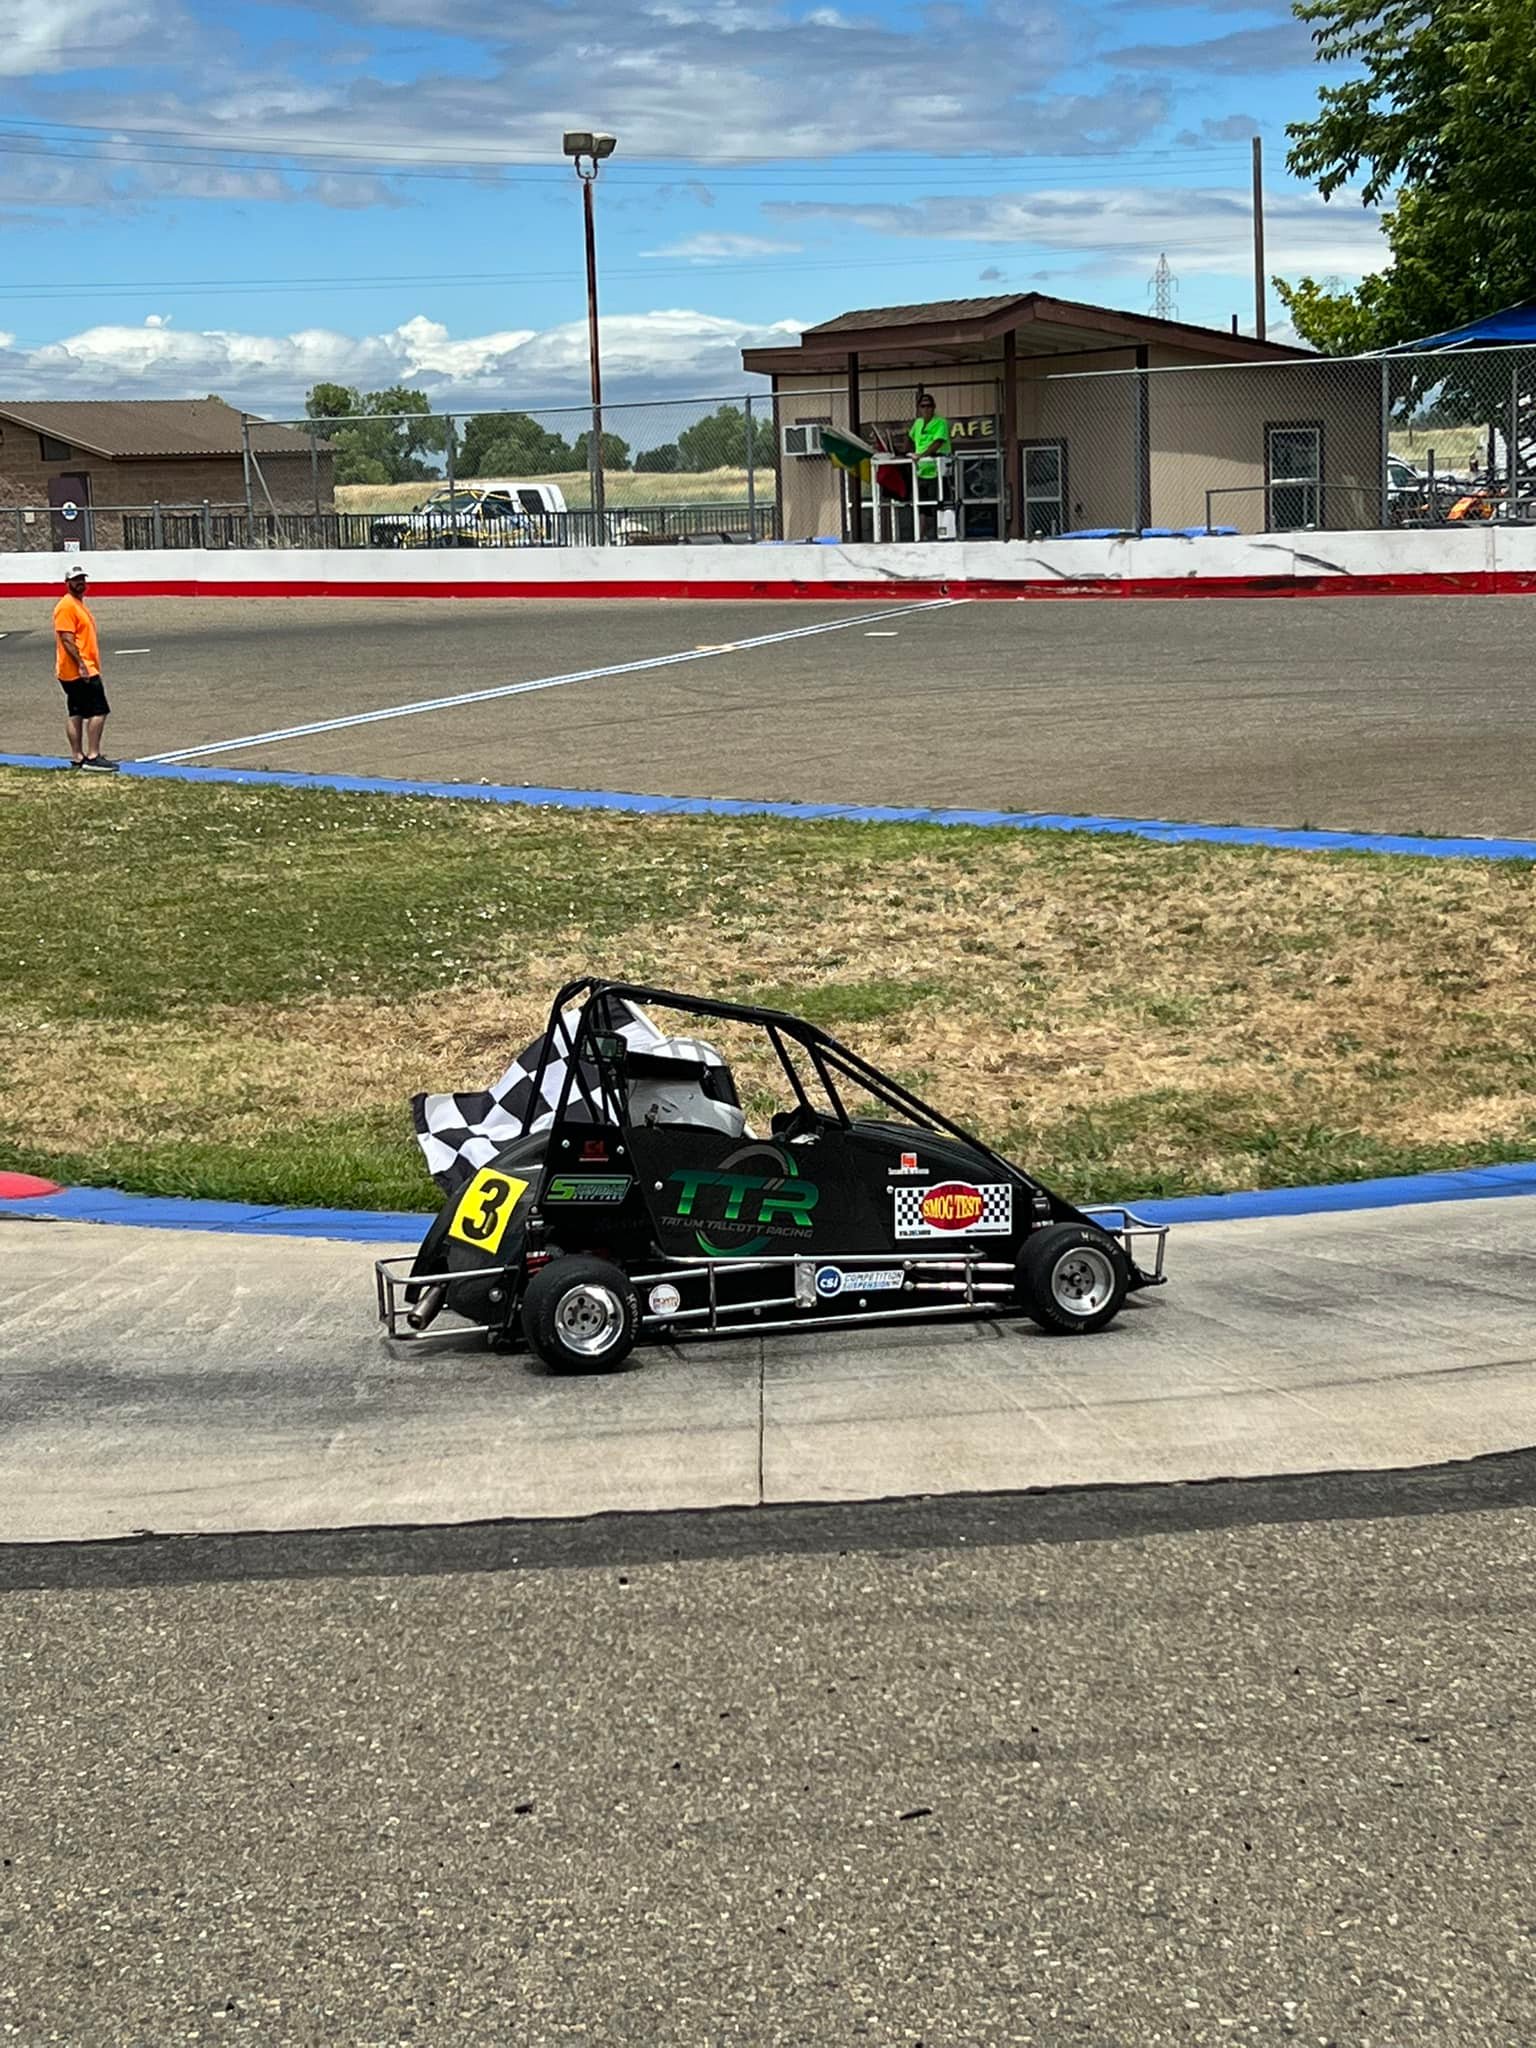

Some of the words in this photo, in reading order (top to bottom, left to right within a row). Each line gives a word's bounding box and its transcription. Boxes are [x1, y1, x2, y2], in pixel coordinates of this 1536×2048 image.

[951, 420, 994, 438] AFE
[668, 1168, 819, 1226] TTR
[923, 1196, 953, 1219] SMOG
[955, 1195, 982, 1218] TEST
[462, 1178, 511, 1240] 3
[660, 1216, 703, 1228] TATUM
[707, 1221, 762, 1234] TALCOTT
[766, 1225, 814, 1239] RACING
[844, 1271, 903, 1282] COMPETITION
